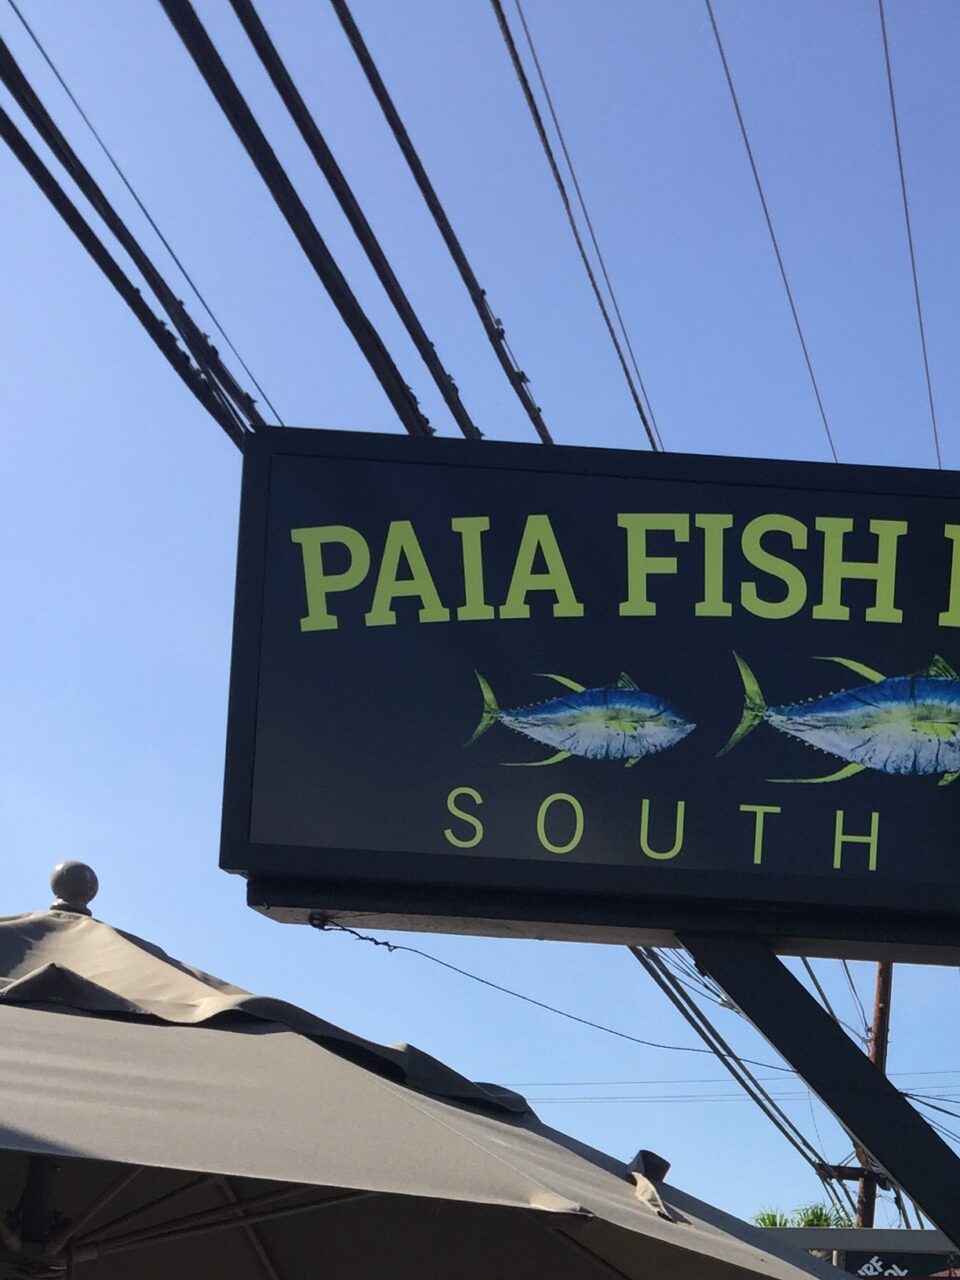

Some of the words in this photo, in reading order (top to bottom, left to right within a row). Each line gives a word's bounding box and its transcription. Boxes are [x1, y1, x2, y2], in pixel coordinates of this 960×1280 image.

[291, 515, 583, 630] PAIA
[618, 513, 908, 623] FISH
[443, 786, 880, 871] SOUTH
